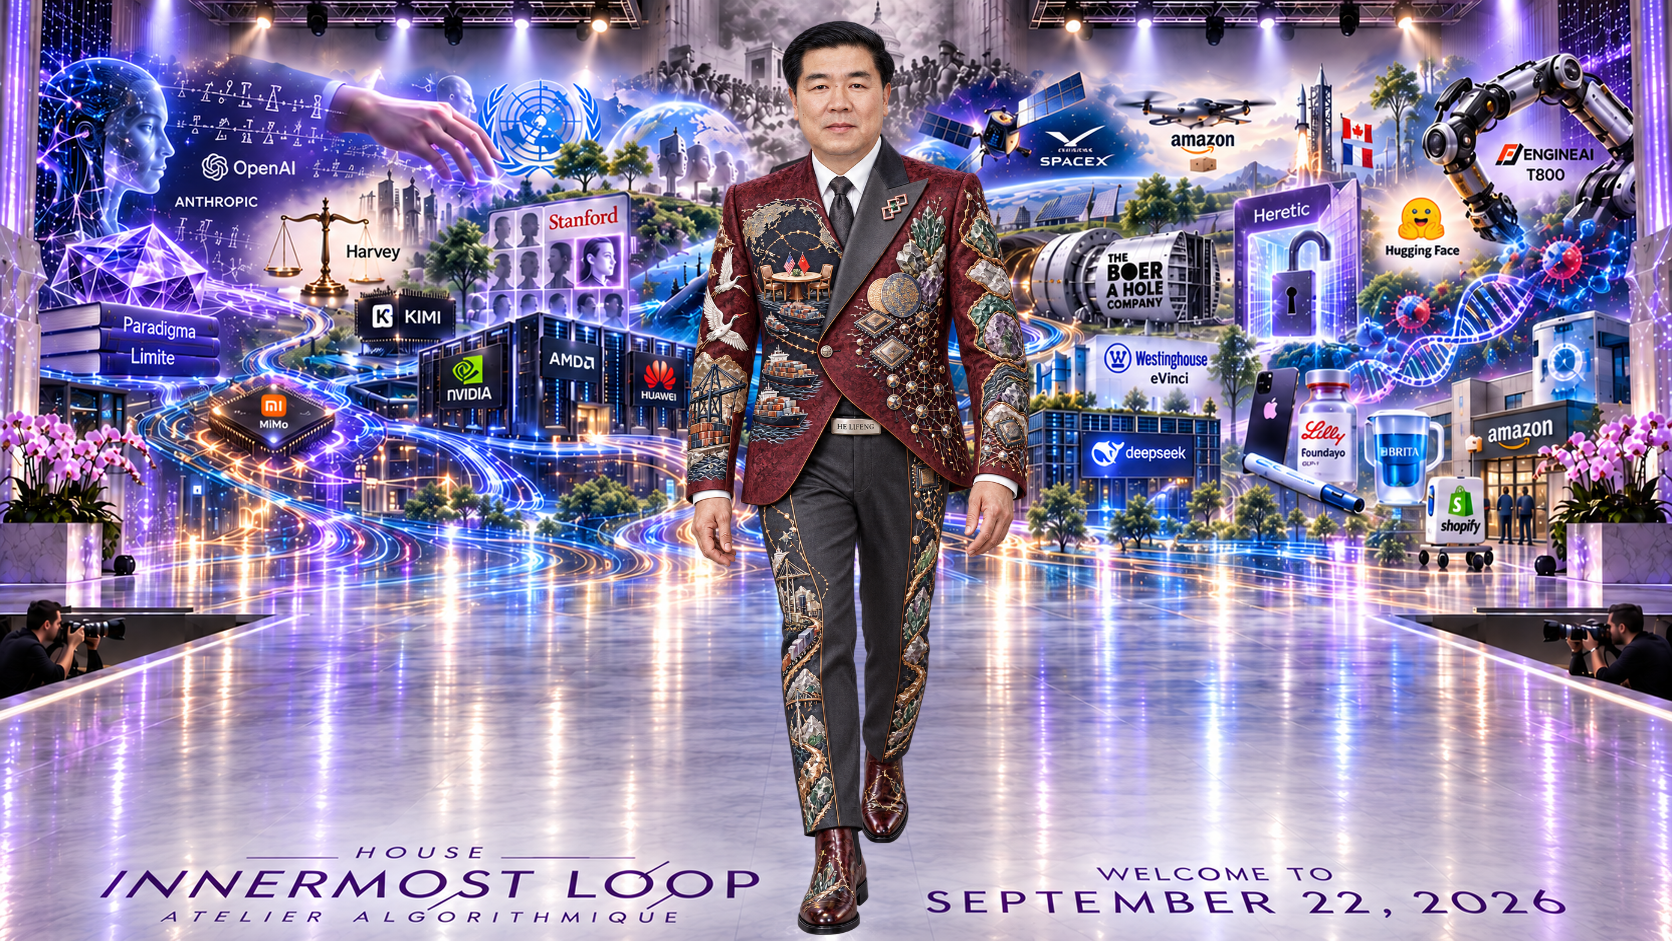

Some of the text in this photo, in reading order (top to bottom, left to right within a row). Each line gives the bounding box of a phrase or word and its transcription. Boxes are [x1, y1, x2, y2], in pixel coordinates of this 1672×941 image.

[1171, 133, 1235, 147] amazon
[1040, 154, 1115, 167] SPACEX
[1524, 148, 1594, 161] ENGINEAI
[233, 159, 296, 179] OpenAI
[1526, 168, 1565, 182] T800
[174, 196, 258, 208] ANTHROPIC
[549, 206, 619, 230] Stanford
[1253, 202, 1310, 223] Heretic
[346, 244, 401, 262] Harvey
[1108, 252, 1128, 263] THE
[1385, 245, 1460, 260] Hugging Face
[1107, 262, 1163, 281] BOER
[1107, 281, 1164, 298] A HOLE
[1107, 297, 1164, 310] COMPANY
[405, 309, 441, 325] KIMI
[123, 315, 196, 340] Paradigma
[131, 347, 175, 366] Limite
[549, 351, 582, 370] AMD
[1135, 349, 1208, 369] Westinghouse
[1150, 370, 1189, 385] eVinci
[641, 390, 677, 402] HUAWEI
[259, 419, 289, 429] MiMo
[1488, 417, 1554, 444] amazon
[1301, 420, 1346, 446] Lilly
[1125, 444, 1187, 462] deepseek
[1301, 447, 1346, 460] Foundayo
[1388, 446, 1420, 457] BRITA
[1440, 518, 1481, 535] shopify
[354, 845, 485, 860] HOUSE
[1096, 866, 1333, 882] WELCOME TO
[100, 864, 761, 910] INNERMOST LOOP
[926, 888, 1567, 919] SEPTEMBER 22, 2026
[160, 911, 680, 924] ATELIER ALGORITHMIQUE
